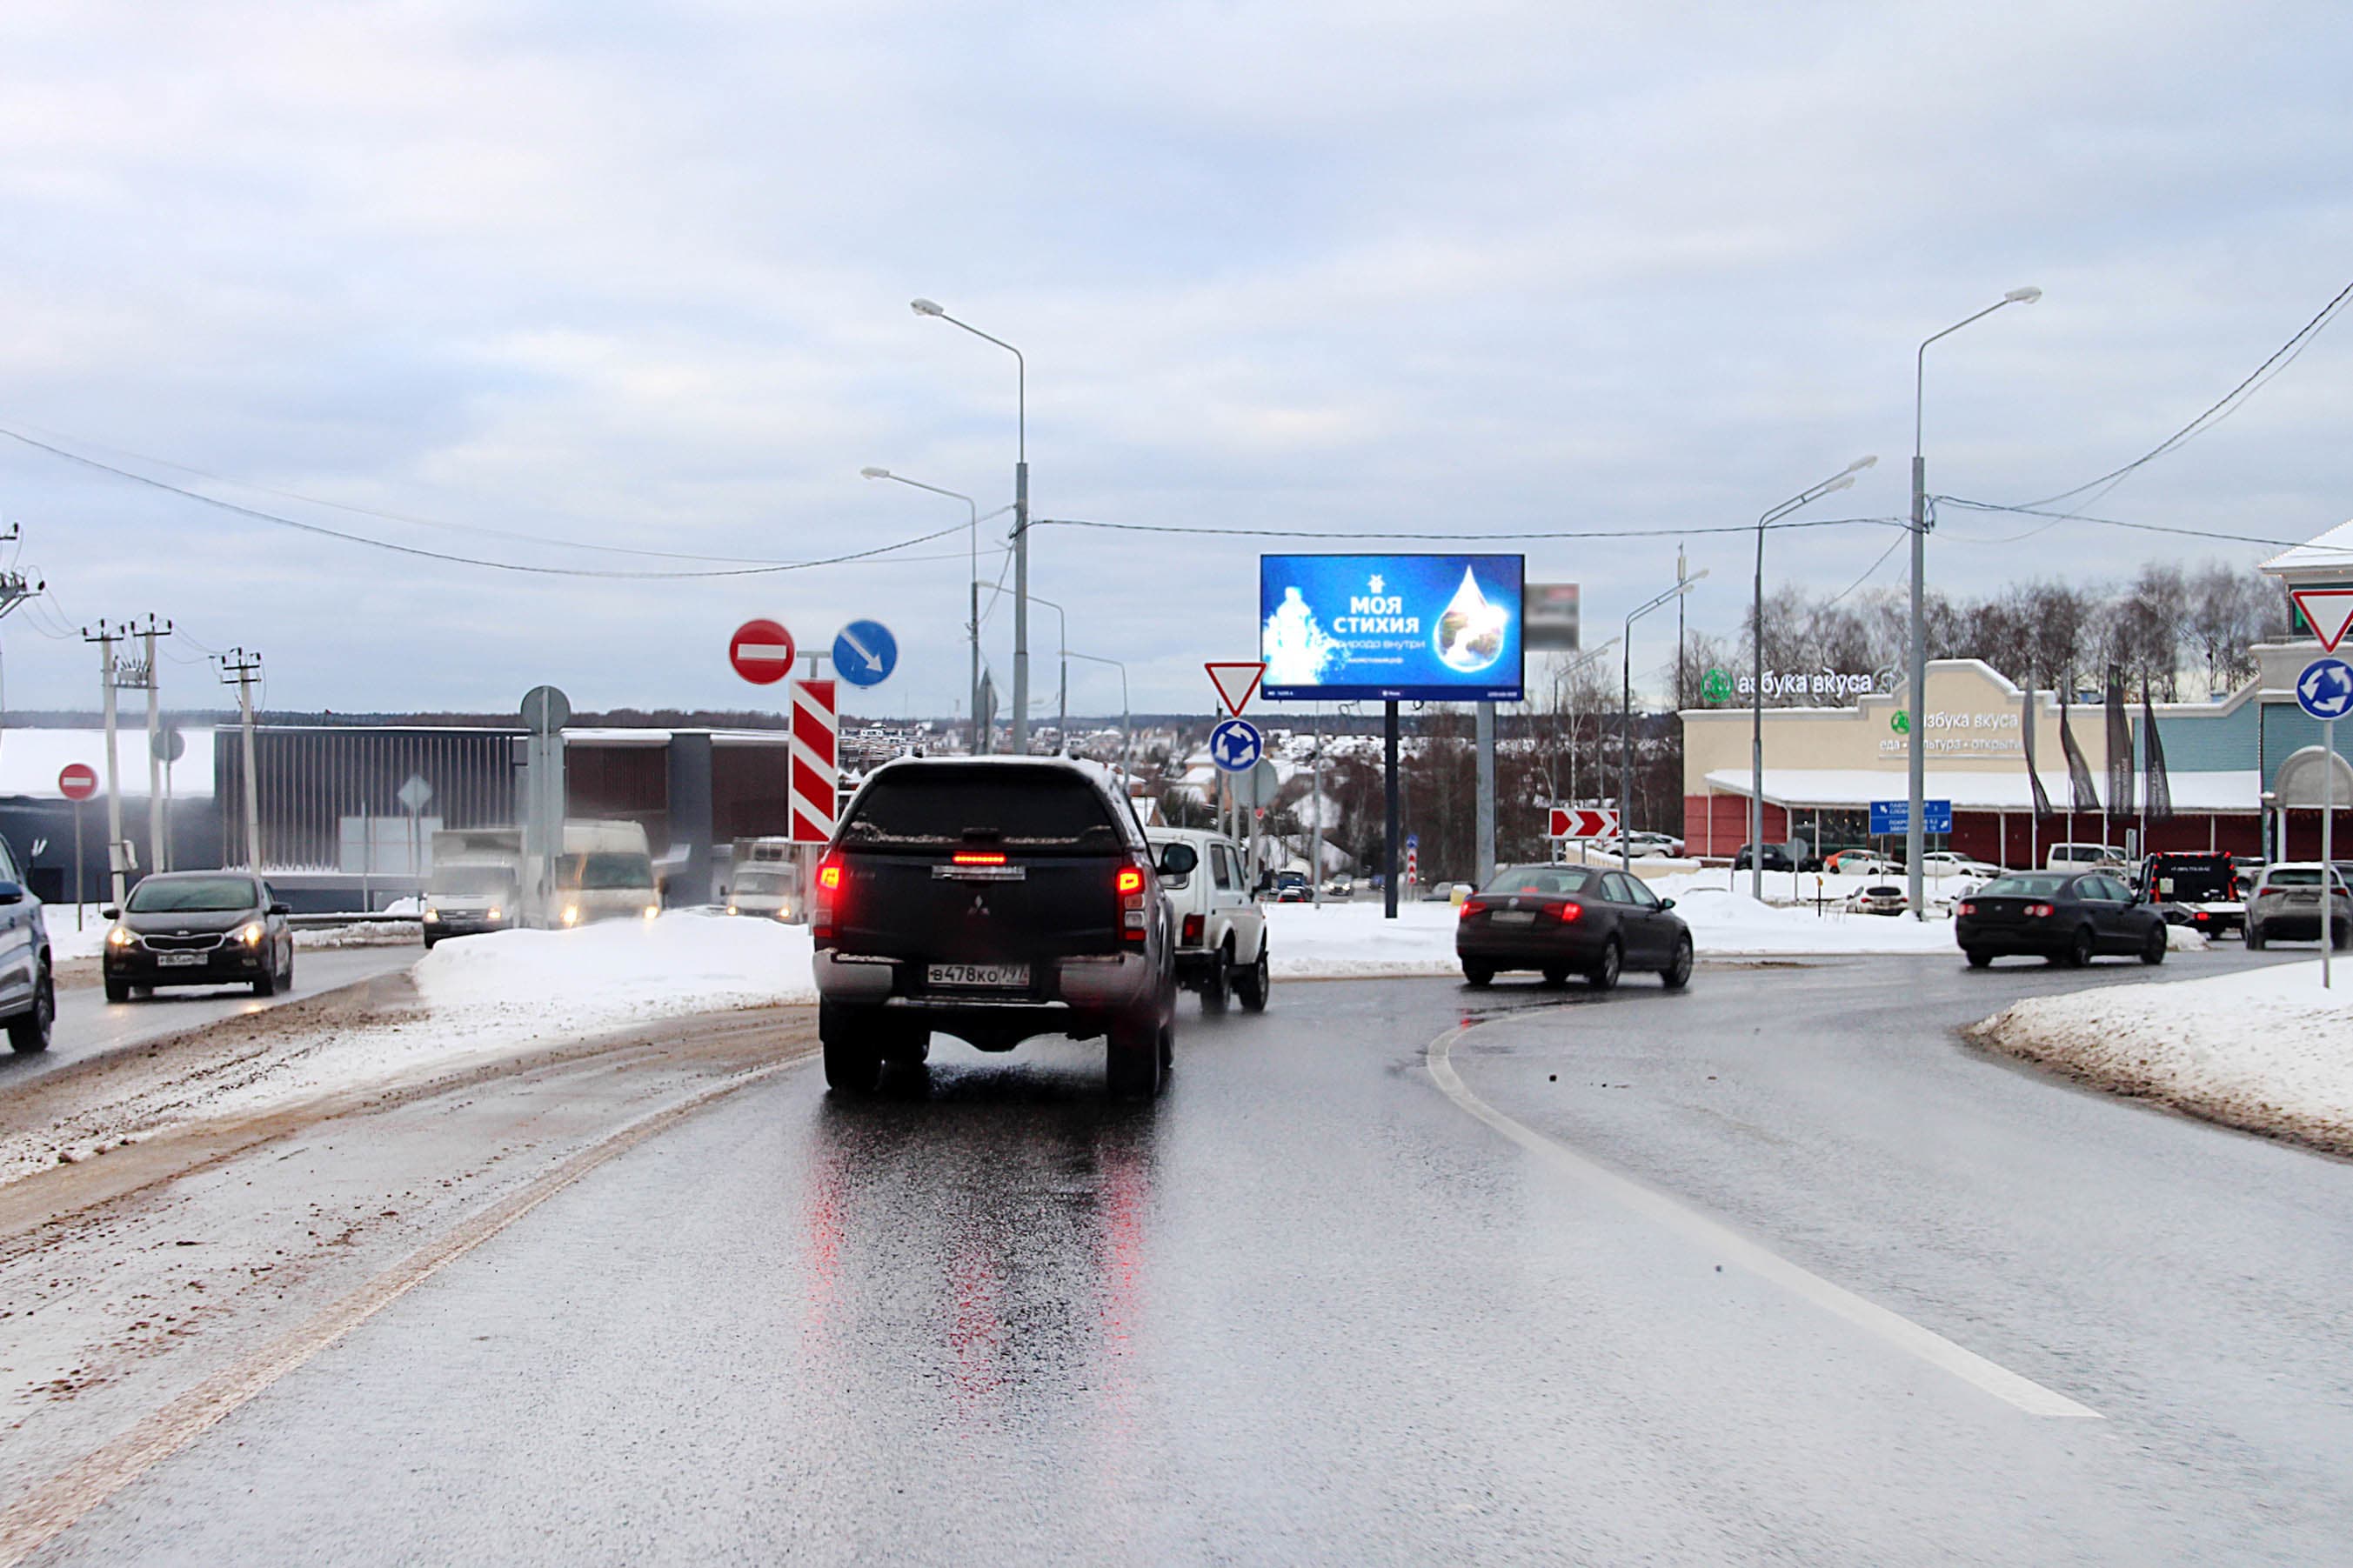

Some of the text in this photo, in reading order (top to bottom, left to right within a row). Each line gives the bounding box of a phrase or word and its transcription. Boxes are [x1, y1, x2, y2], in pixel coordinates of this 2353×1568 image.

[1350, 597, 1402, 614] МОЯ
[1334, 617, 1420, 633] СТИХИЯ
[1383, 639, 1427, 651] внутри
[1813, 667, 1872, 700] вкуса
[1923, 711, 2019, 731] збука вкуса
[1879, 740, 1900, 752] еда
[1923, 739, 1961, 753] льтура
